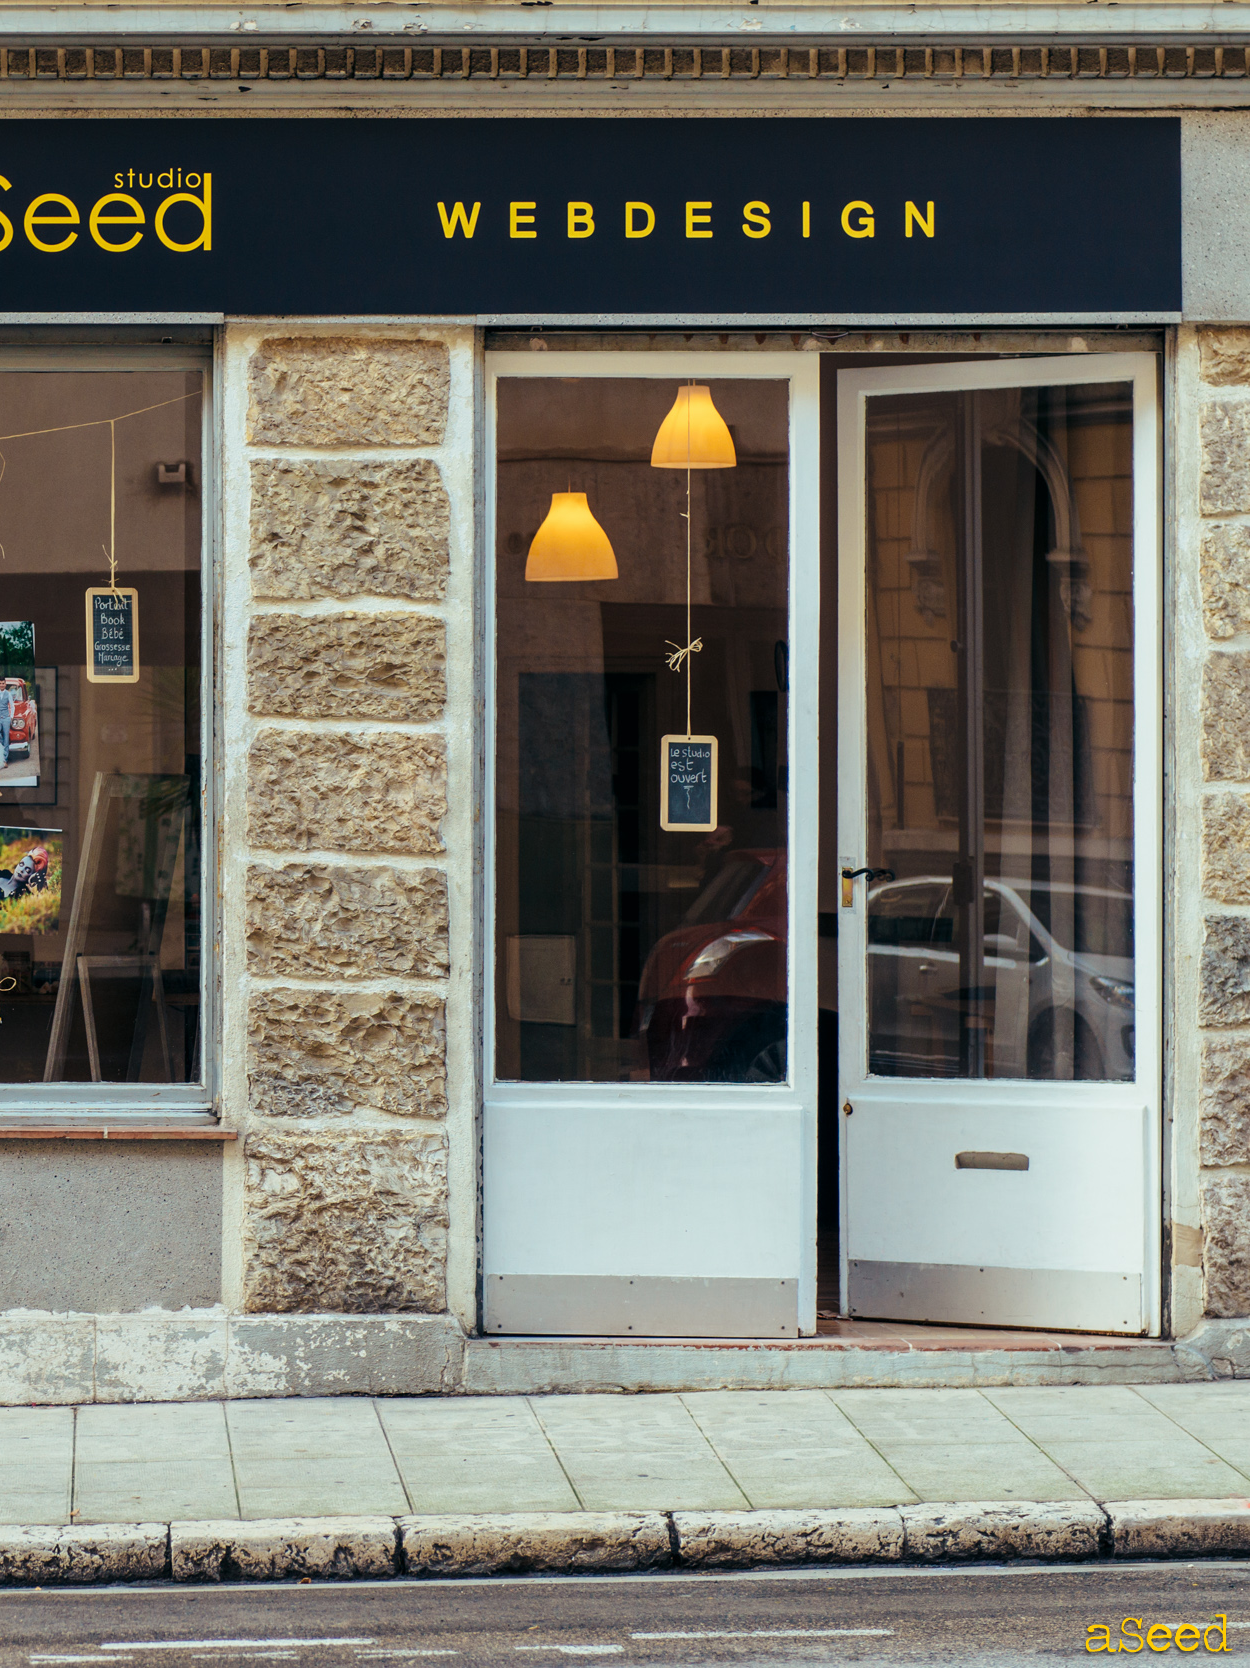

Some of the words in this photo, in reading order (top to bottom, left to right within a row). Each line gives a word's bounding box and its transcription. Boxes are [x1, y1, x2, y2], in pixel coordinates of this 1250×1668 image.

[113, 167, 202, 189] studio
[436, 200, 935, 239] WEBDESIGN
[100, 612, 126, 625] Book
[101, 627, 124, 640] Bébé
[94, 641, 131, 652] Grossesse
[97, 652, 130, 667] Mariage
[670, 748, 680, 758] Le
[681, 745, 711, 758] studio
[670, 758, 694, 771] est
[670, 768, 707, 783] ouvert
